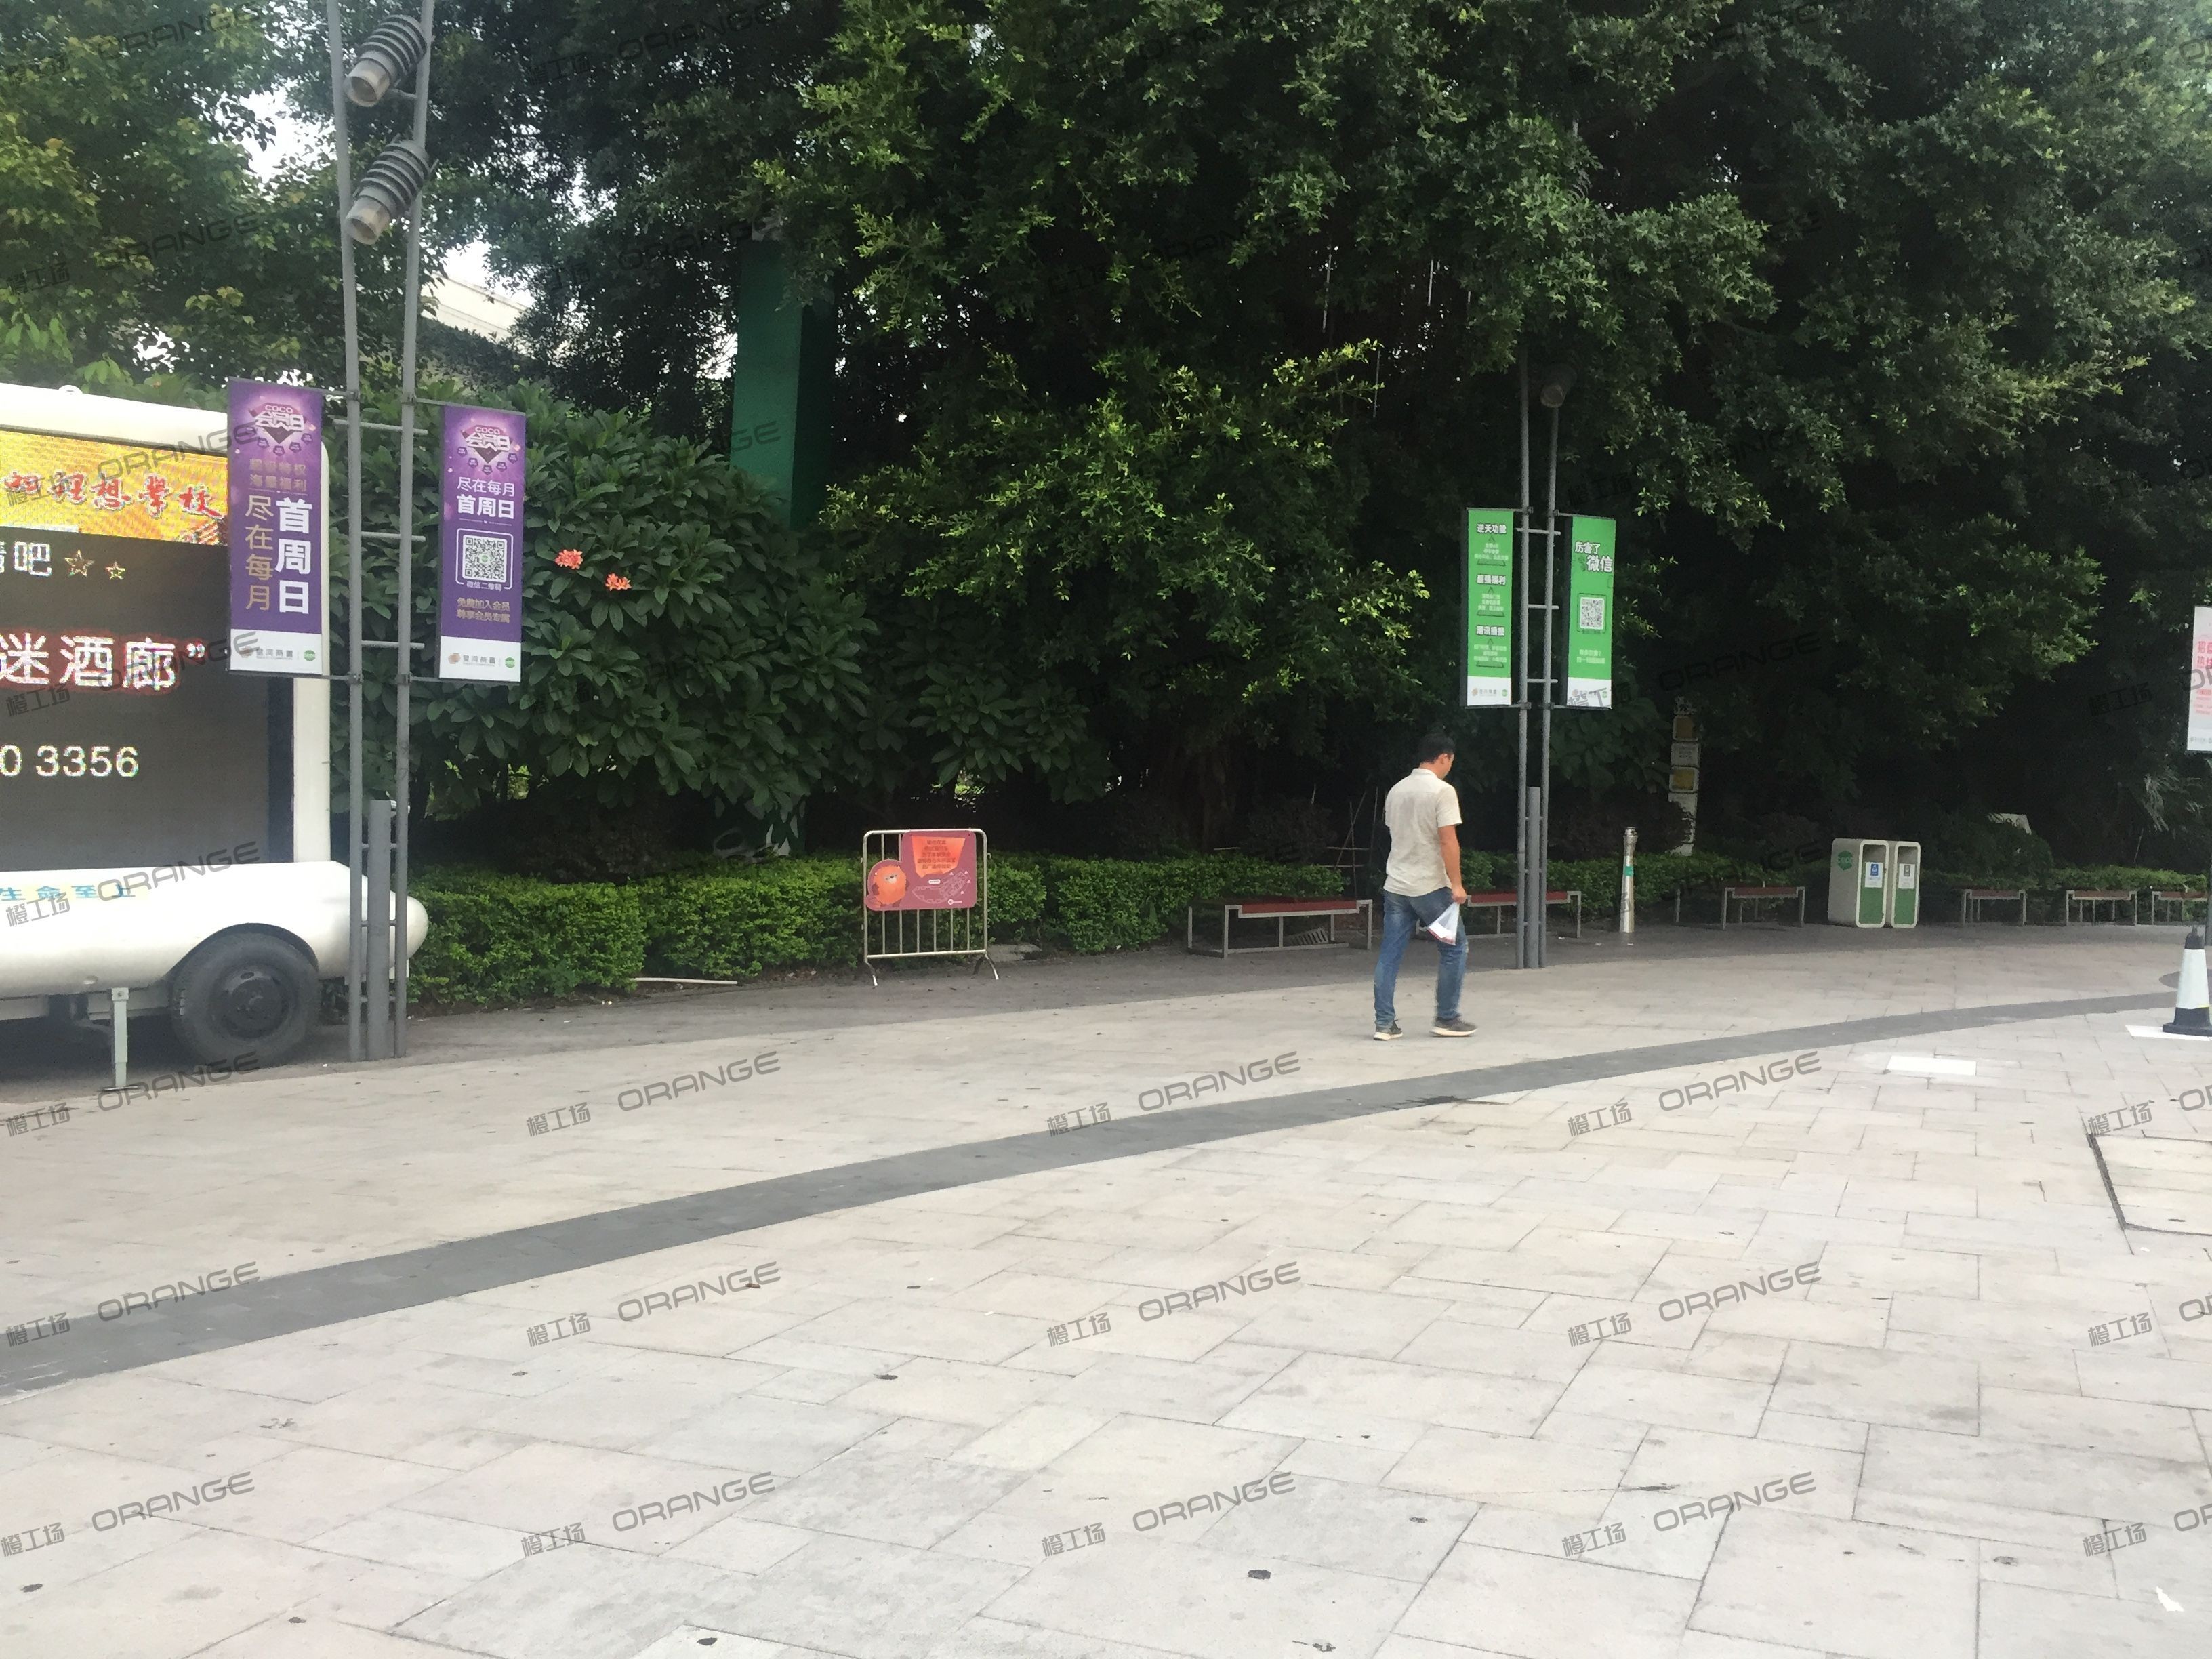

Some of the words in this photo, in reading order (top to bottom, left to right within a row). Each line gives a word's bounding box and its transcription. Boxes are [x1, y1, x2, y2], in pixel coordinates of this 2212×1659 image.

[265, 404, 293, 414] COCO
[253, 410, 305, 432] 会员日
[475, 426, 501, 435] COCO
[465, 432, 511, 452] 会员日
[457, 476, 515, 497] 尽在每月
[457, 494, 515, 520] 首周日
[245, 494, 274, 611] 尽在每月
[274, 497, 313, 615] 首周日
[1574, 541, 1601, 554] 厉害了
[0, 539, 52, 577] 吧
[1586, 554, 1613, 573] 微信
[466, 581, 502, 592] 微信二维码
[457, 597, 510, 611] 免费加入会员
[35, 745, 140, 777] 3356
[0, 884, 136, 901] 生命至上
